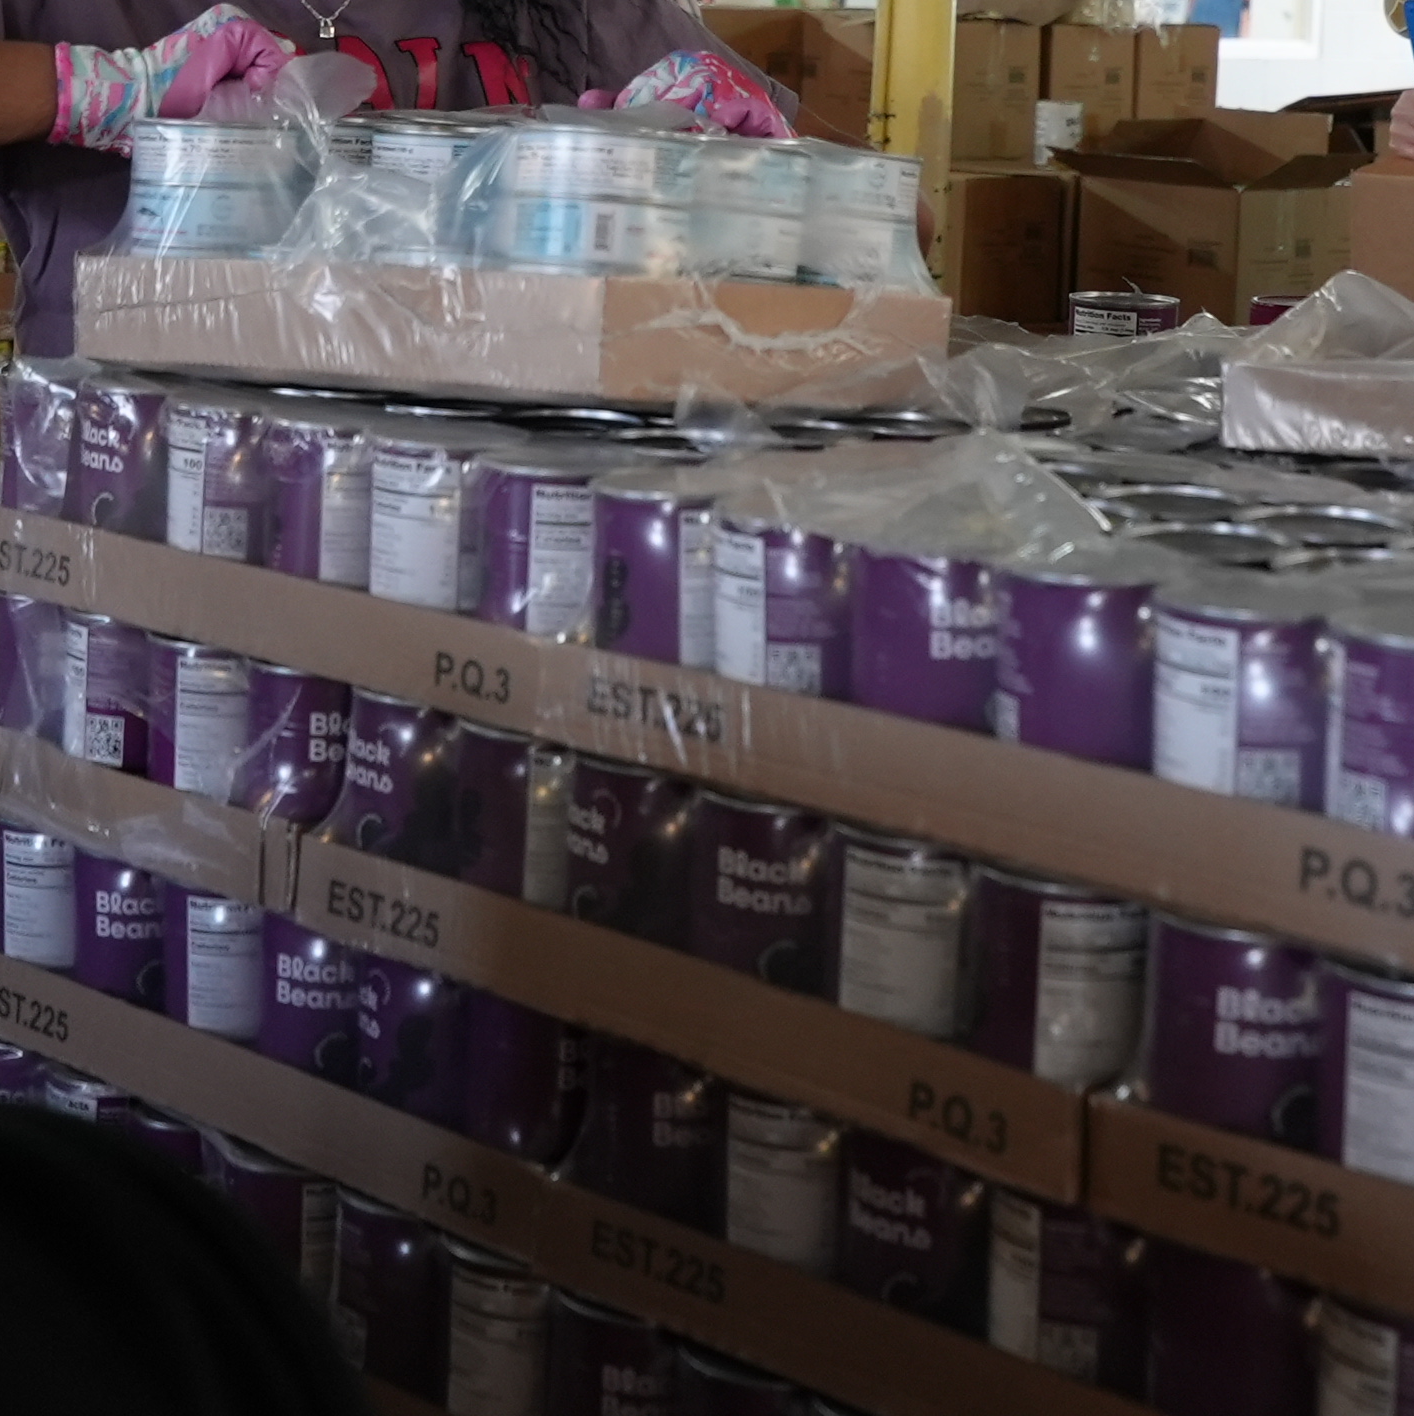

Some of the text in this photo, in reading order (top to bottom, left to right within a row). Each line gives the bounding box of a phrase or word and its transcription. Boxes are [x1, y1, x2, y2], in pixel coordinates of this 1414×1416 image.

[1107, 313, 1132, 321] Facts
[929, 598, 993, 629] Bla
[929, 630, 995, 660] Bea
[433, 651, 512, 705] P.Q.3
[348, 729, 391, 766] lack
[96, 891, 156, 916] Blac
[327, 880, 439, 949] EST.225
[96, 915, 163, 940] Bean
[907, 1081, 1009, 1153] P.Q.3
[422, 1164, 498, 1227] P.Q.3
[1157, 1143, 1341, 1237] EST.225
[591, 1220, 726, 1305] EST.225
